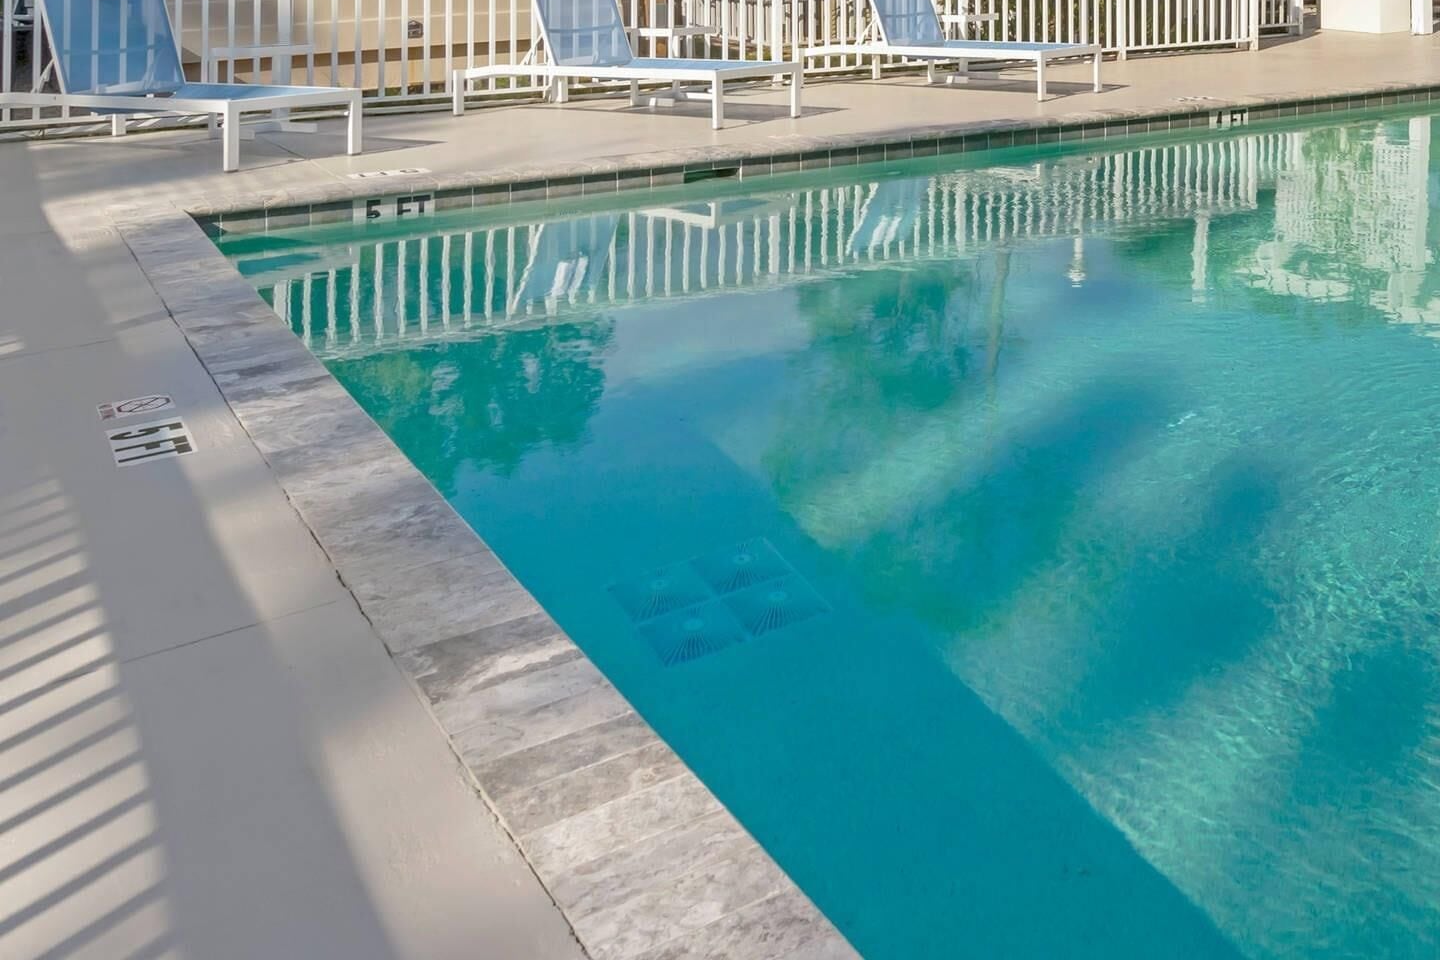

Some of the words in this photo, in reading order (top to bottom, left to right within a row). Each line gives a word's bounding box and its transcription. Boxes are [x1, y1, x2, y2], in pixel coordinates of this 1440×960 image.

[1230, 108, 1247, 123] FT
[366, 199, 381, 219] 5
[397, 194, 432, 216] FT
[109, 422, 184, 441] 5
[114, 435, 193, 463] FT
